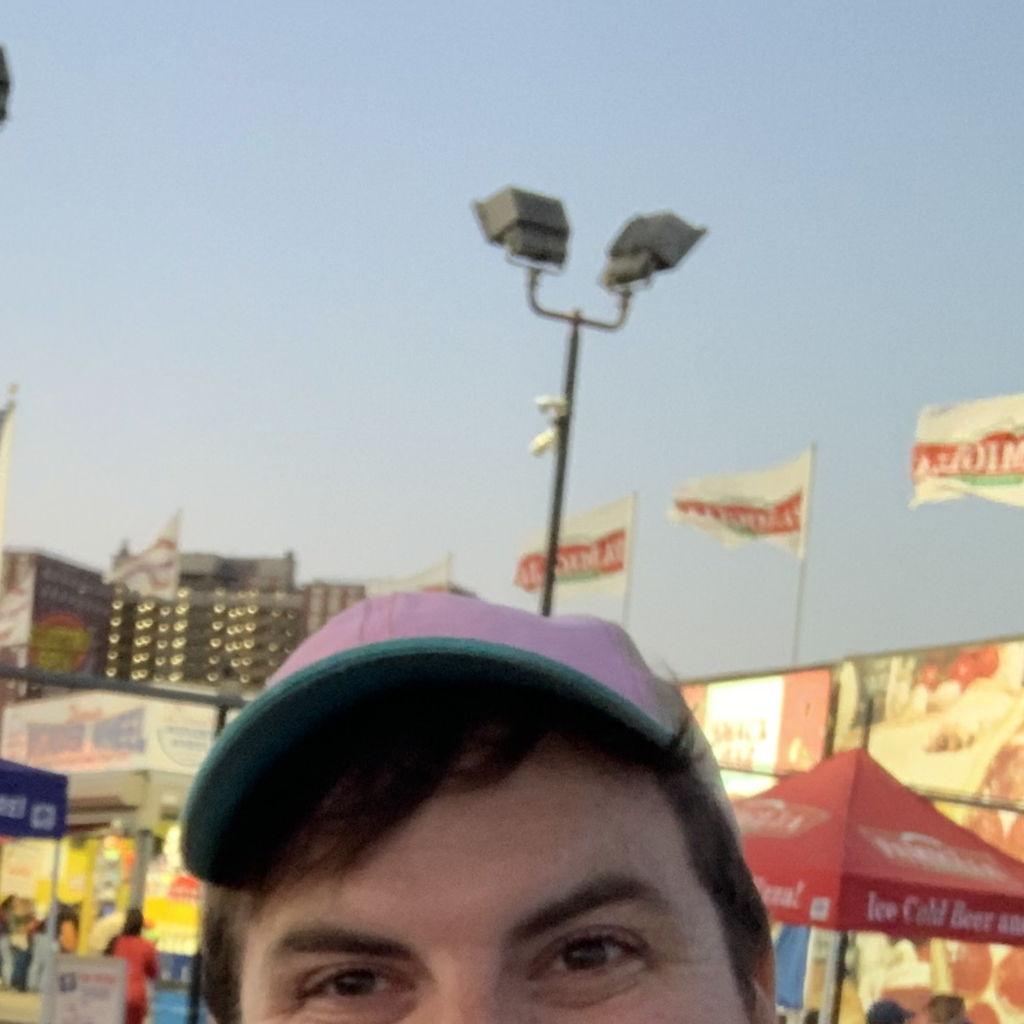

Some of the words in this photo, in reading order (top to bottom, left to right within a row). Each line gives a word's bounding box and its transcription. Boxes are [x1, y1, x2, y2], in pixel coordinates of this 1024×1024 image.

[867, 889, 898, 923] Ice
[902, 895, 948, 928] Cold
[950, 899, 995, 933] Beer
